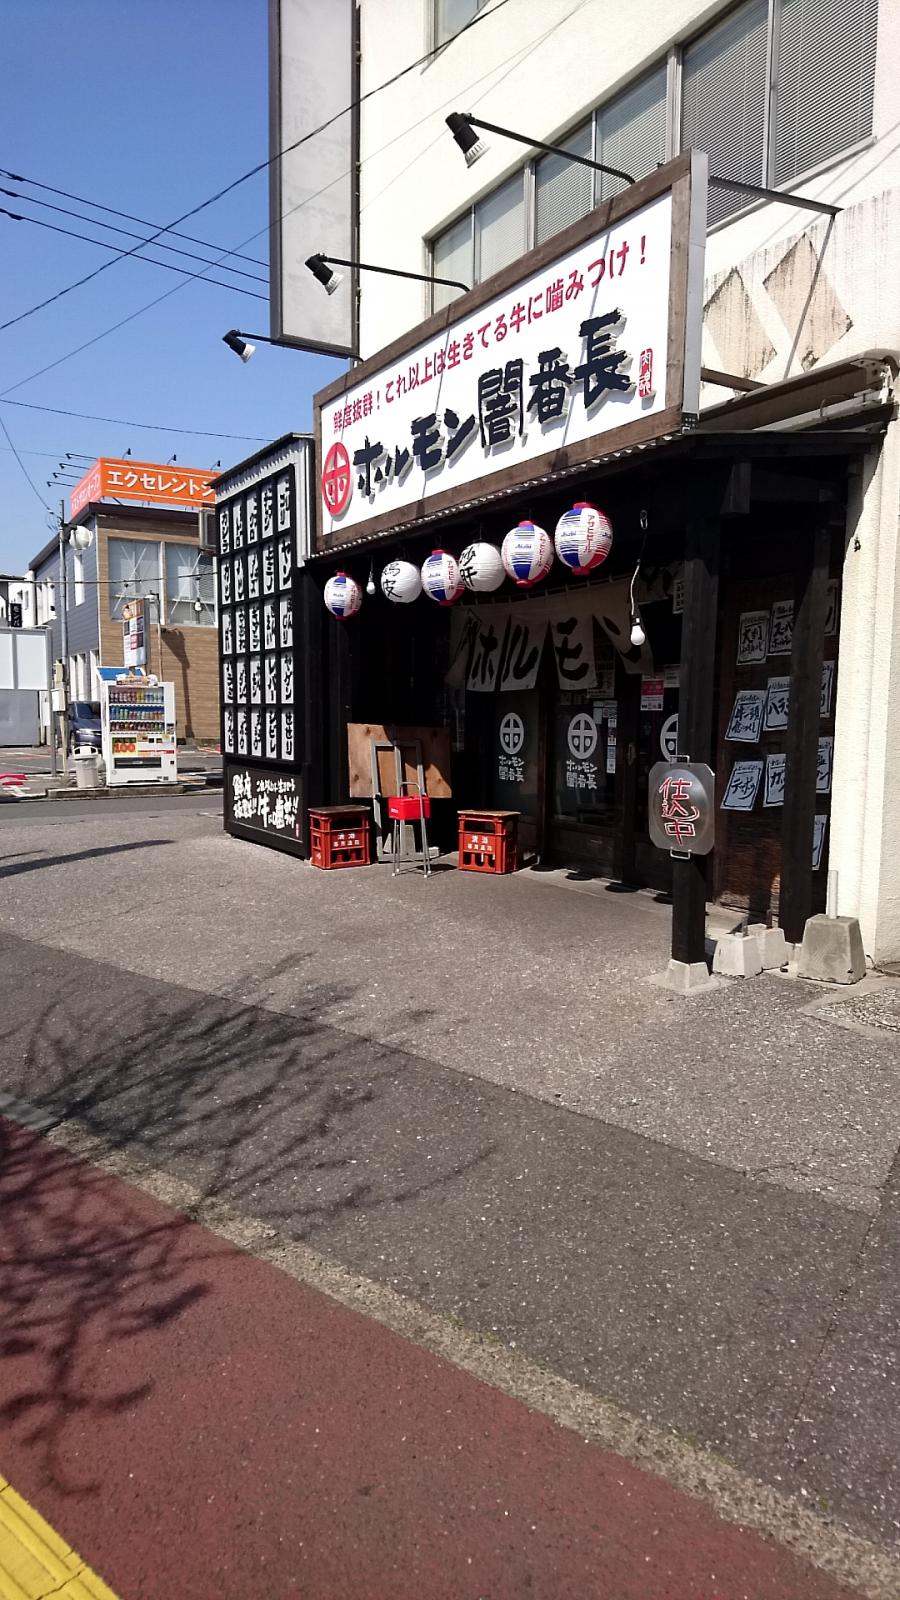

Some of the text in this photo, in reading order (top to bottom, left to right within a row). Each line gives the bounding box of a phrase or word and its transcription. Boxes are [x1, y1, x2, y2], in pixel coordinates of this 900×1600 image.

[354, 308, 632, 497] ホルモン闇番長
[285, 711, 293, 756] せせり
[566, 760, 598, 773] ホルモン
[659, 776, 700, 846] 仕込中
